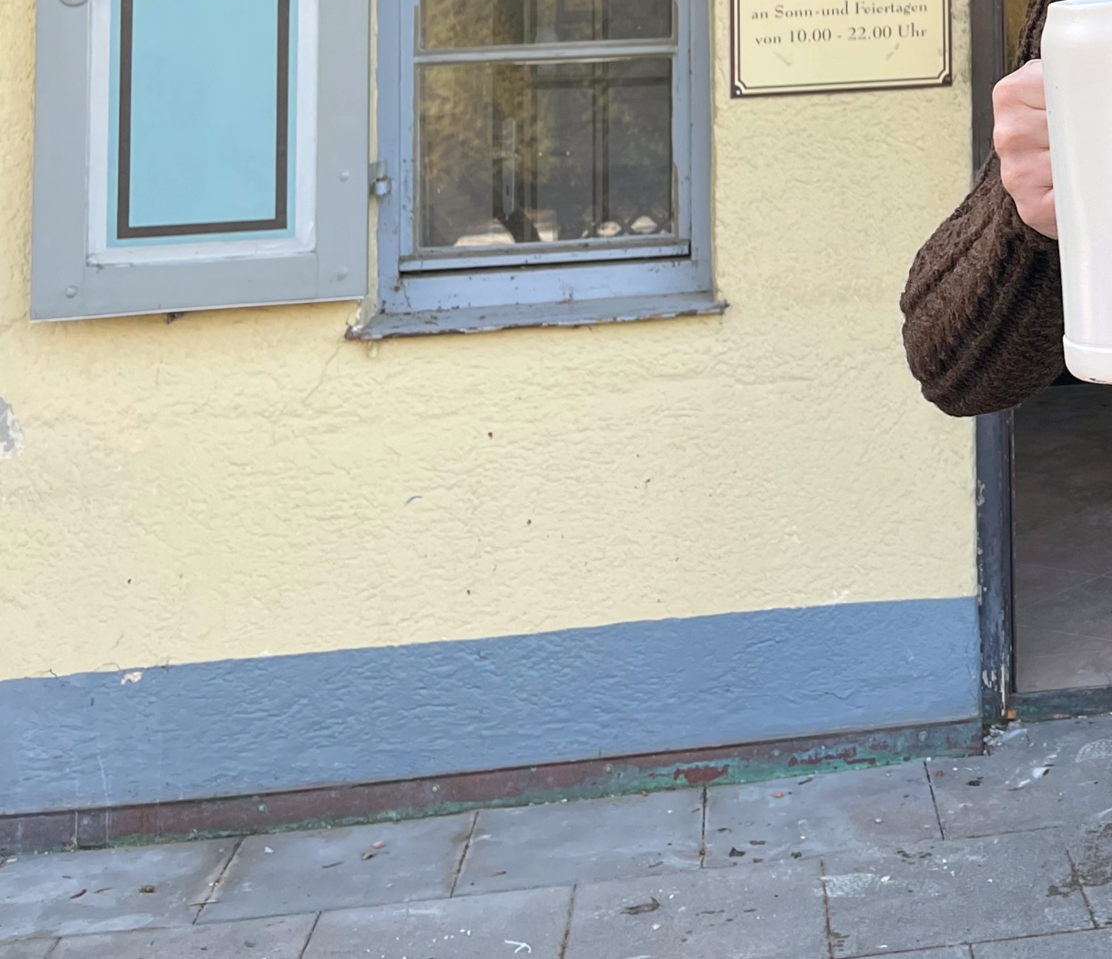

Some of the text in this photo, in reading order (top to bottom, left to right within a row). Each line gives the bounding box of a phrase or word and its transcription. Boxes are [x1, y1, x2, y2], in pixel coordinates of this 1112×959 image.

[752, 10, 769, 20] an
[855, 0, 928, 16] Feiertagen
[755, 35, 782, 46] von
[789, 28, 832, 44] 10.00
[847, 25, 892, 41] 22.00
[898, 22, 928, 39] Uhr
